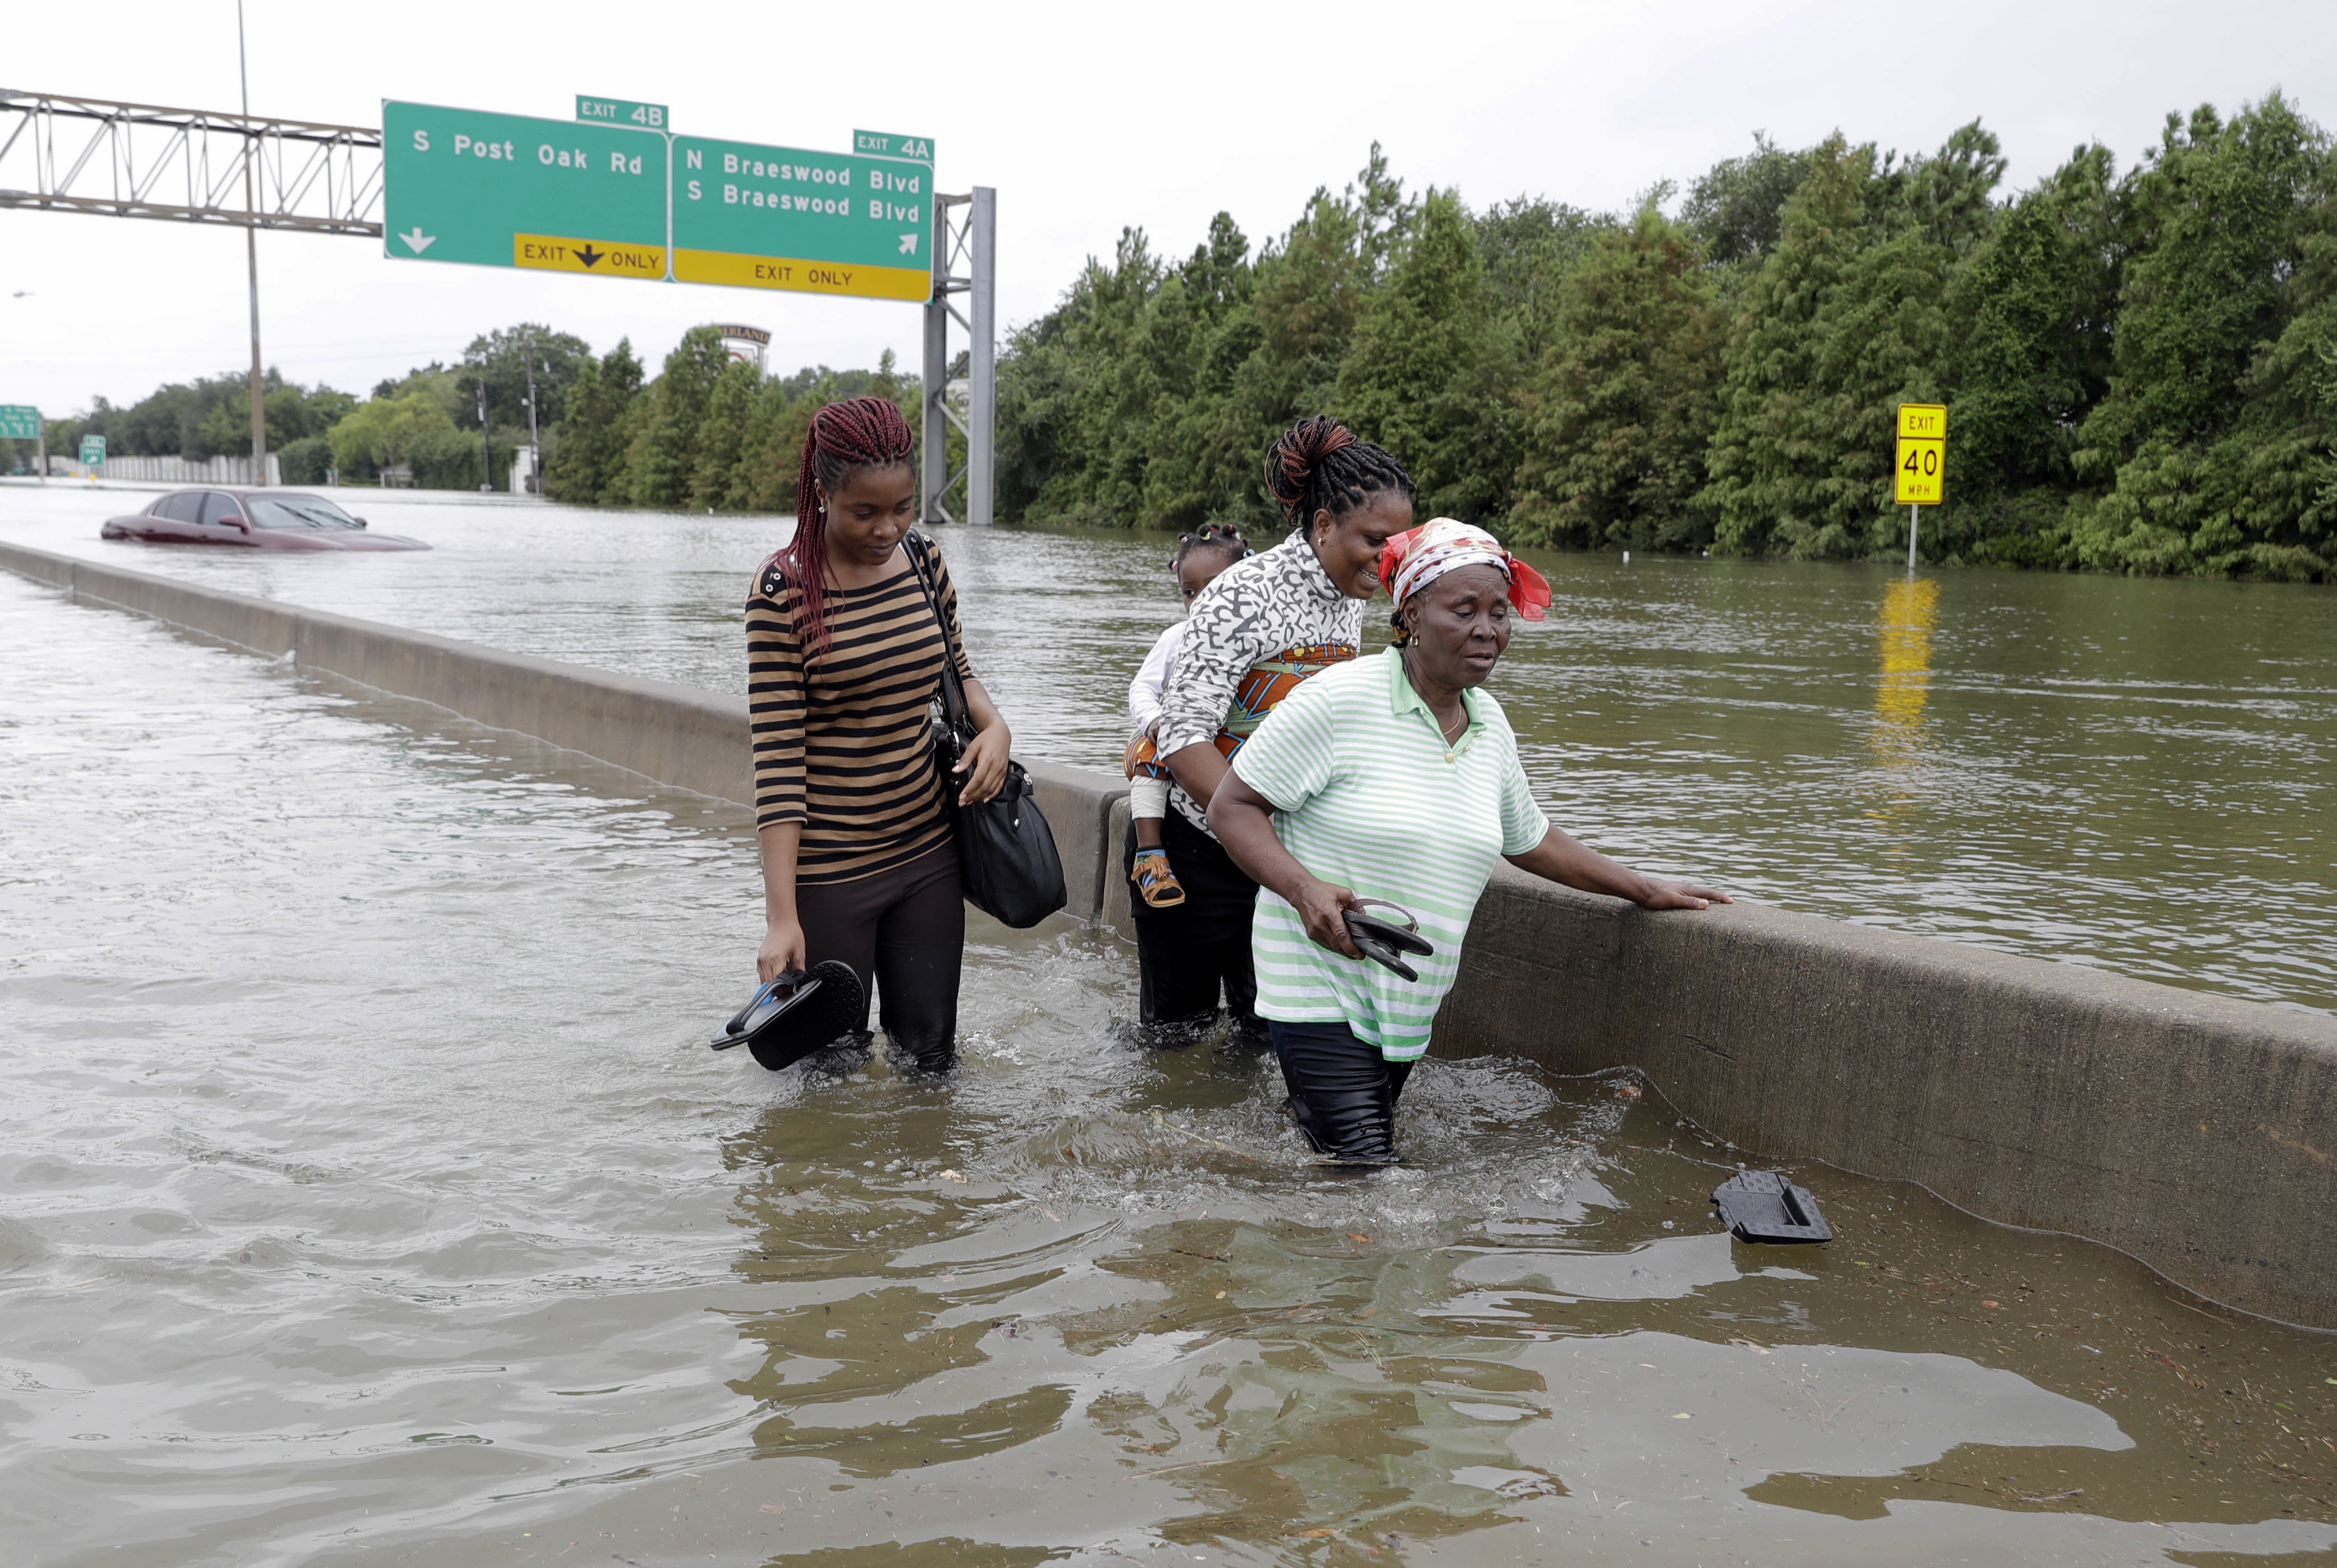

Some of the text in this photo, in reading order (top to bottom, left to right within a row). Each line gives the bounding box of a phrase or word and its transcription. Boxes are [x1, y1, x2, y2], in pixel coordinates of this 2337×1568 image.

[581, 101, 663, 127] EXIT 4B
[413, 130, 642, 175] S Post Oak Rd
[858, 135, 929, 159] EXIT 4A
[686, 149, 920, 194] N Braeswood Blvd
[688, 180, 919, 223] S Braeswood Blvd
[524, 243, 660, 270] EXIT ONLY
[755, 264, 852, 286] EXIT ONLY
[1909, 416, 1934, 431] EXIT
[1903, 449, 1937, 476] 40
[1908, 485, 1930, 495] MPH
